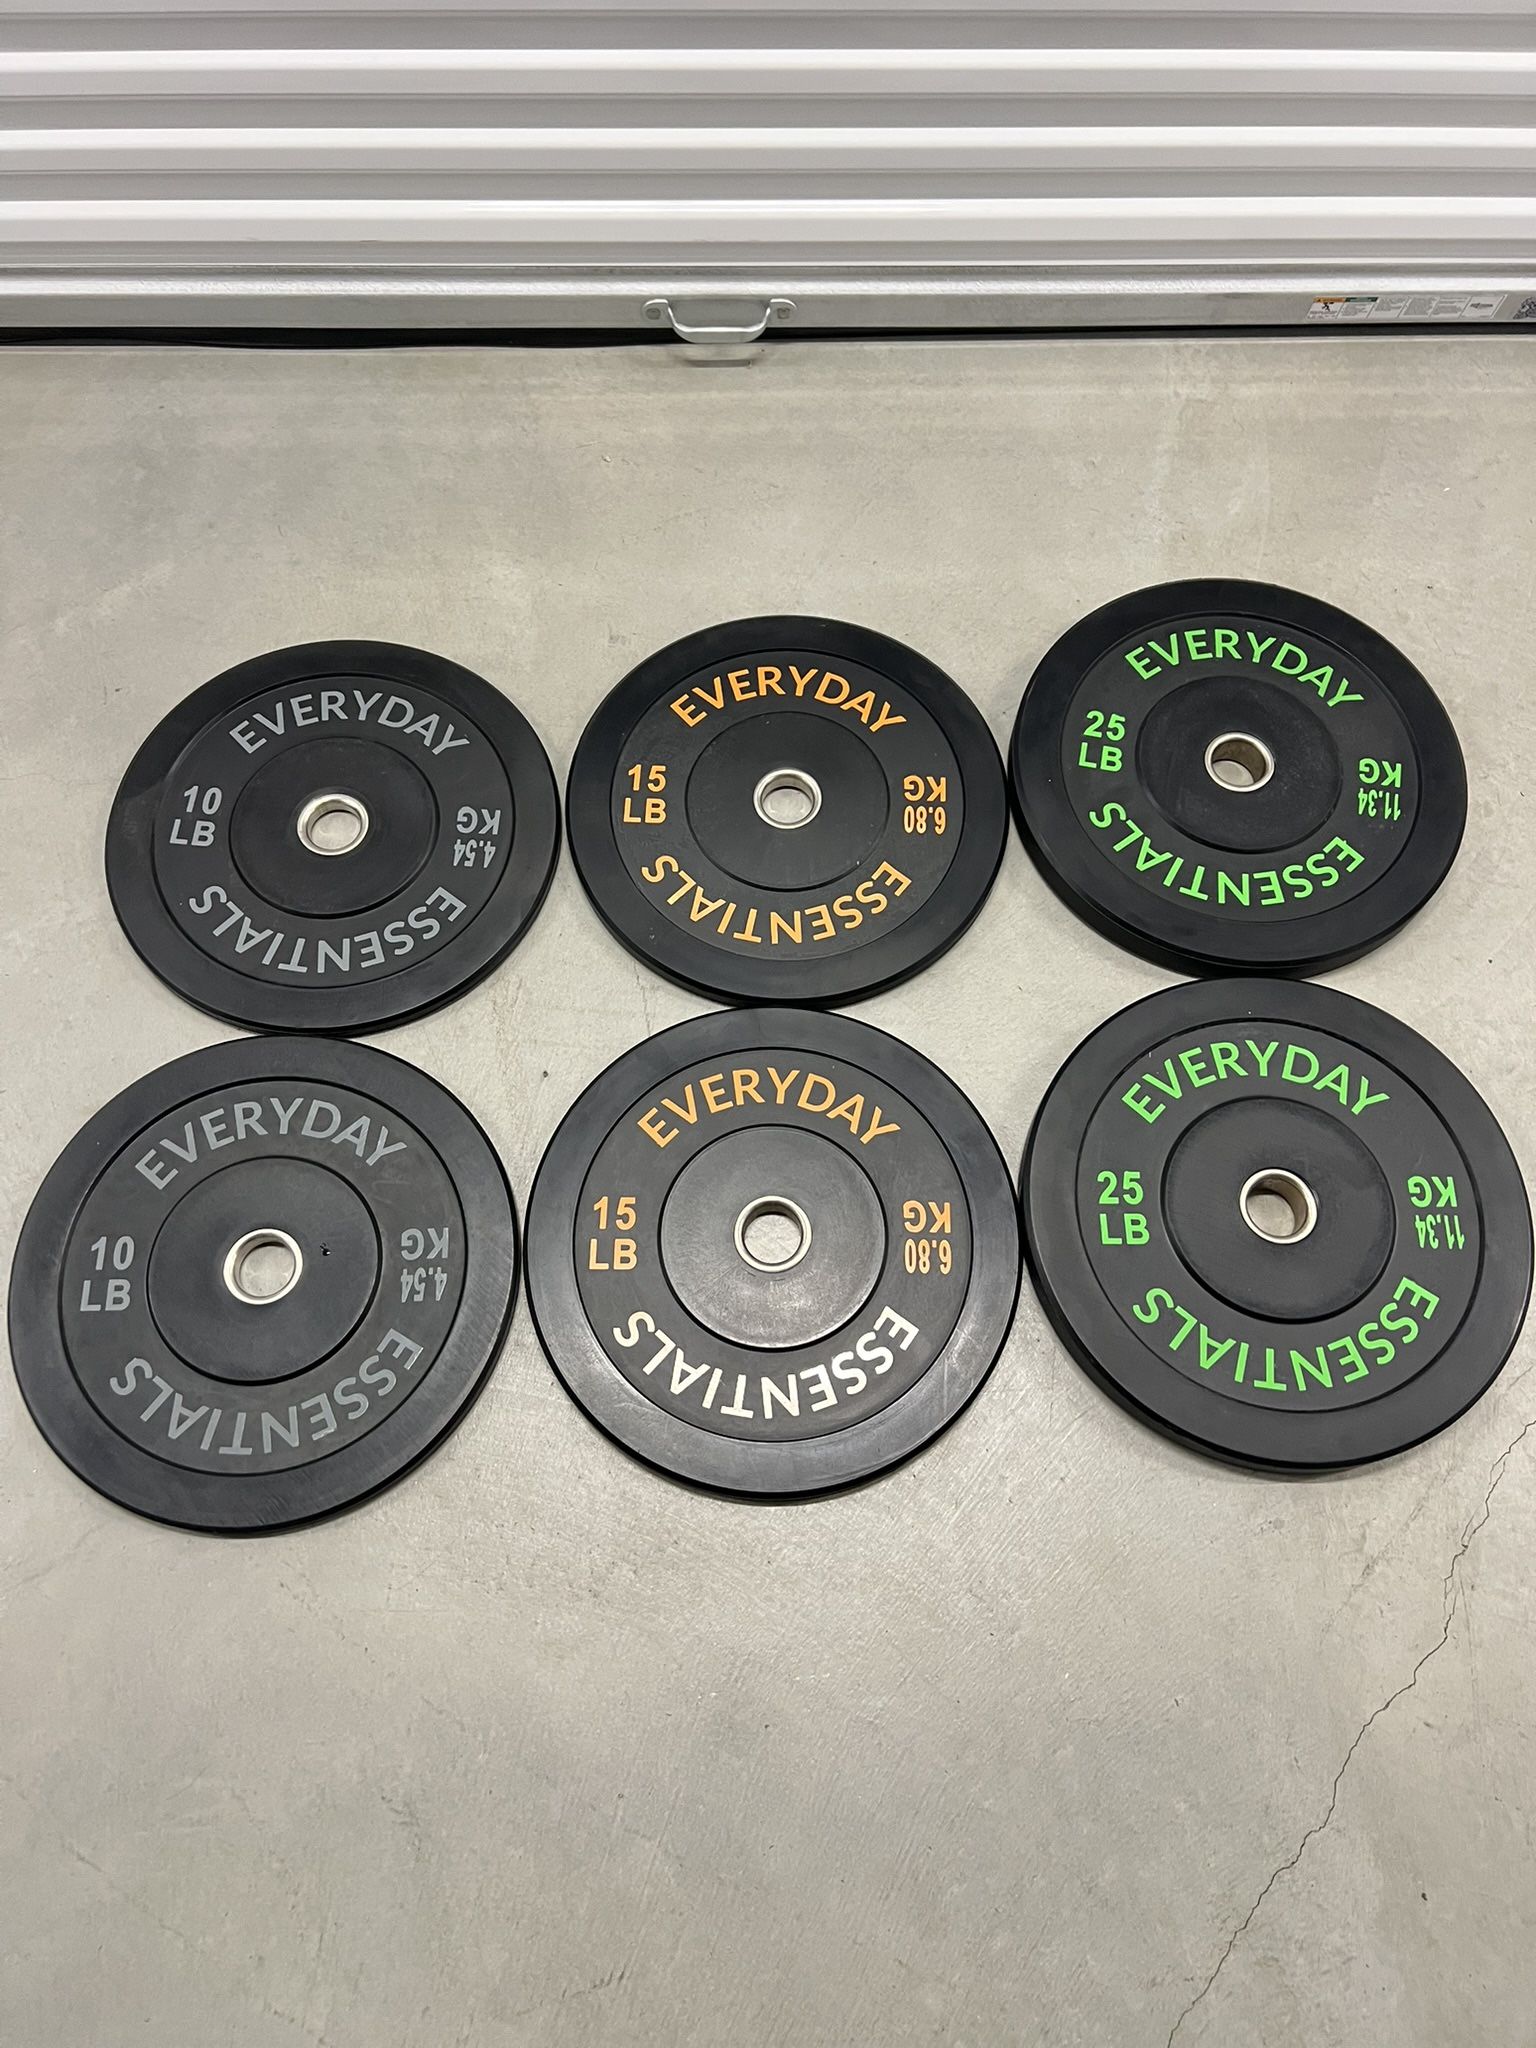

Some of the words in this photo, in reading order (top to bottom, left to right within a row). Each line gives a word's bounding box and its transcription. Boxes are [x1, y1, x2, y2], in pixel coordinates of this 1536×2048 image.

[1124, 628, 1365, 709] EVERYDAY
[669, 665, 907, 733] EVERYDAY
[228, 689, 471, 756] EVERYDAY
[1083, 710, 1126, 741] 25
[1078, 741, 1123, 772] LB
[1358, 758, 1402, 788] KG
[628, 764, 666, 793] 15
[903, 774, 947, 803] KG
[183, 785, 222, 815] 10
[623, 797, 667, 824] LB
[1357, 788, 1401, 821] 11.34
[169, 818, 216, 847] LB
[455, 805, 502, 836] KG
[903, 805, 946, 835] 6.80
[453, 838, 496, 869] 4.54
[1088, 801, 1366, 907] ESSENTIALS
[641, 855, 912, 945] ESSENTIALS
[188, 885, 467, 974] ESSENTIALS
[1121, 1039, 1390, 1124] EVERYDAY
[637, 1067, 901, 1148] EVERYDAY
[134, 1097, 408, 1190] EVERYDAY
[1097, 1170, 1144, 1205] 25
[1407, 1175, 1458, 1208] KG
[593, 1196, 637, 1231] 15
[902, 1200, 952, 1234] KG
[1099, 1213, 1150, 1245] LB
[401, 1227, 449, 1261] KG
[1414, 1214, 1465, 1250] 11.34
[90, 1235, 135, 1271] 10
[588, 1238, 638, 1270] LB
[904, 1238, 952, 1275] 6.80
[79, 1278, 131, 1312] LB
[400, 1266, 448, 1303] 4.54
[1132, 1276, 1440, 1392] ESSENTIALS
[612, 1305, 920, 1420] ESSENTIALS
[109, 1328, 424, 1456] ESSENTIALS
